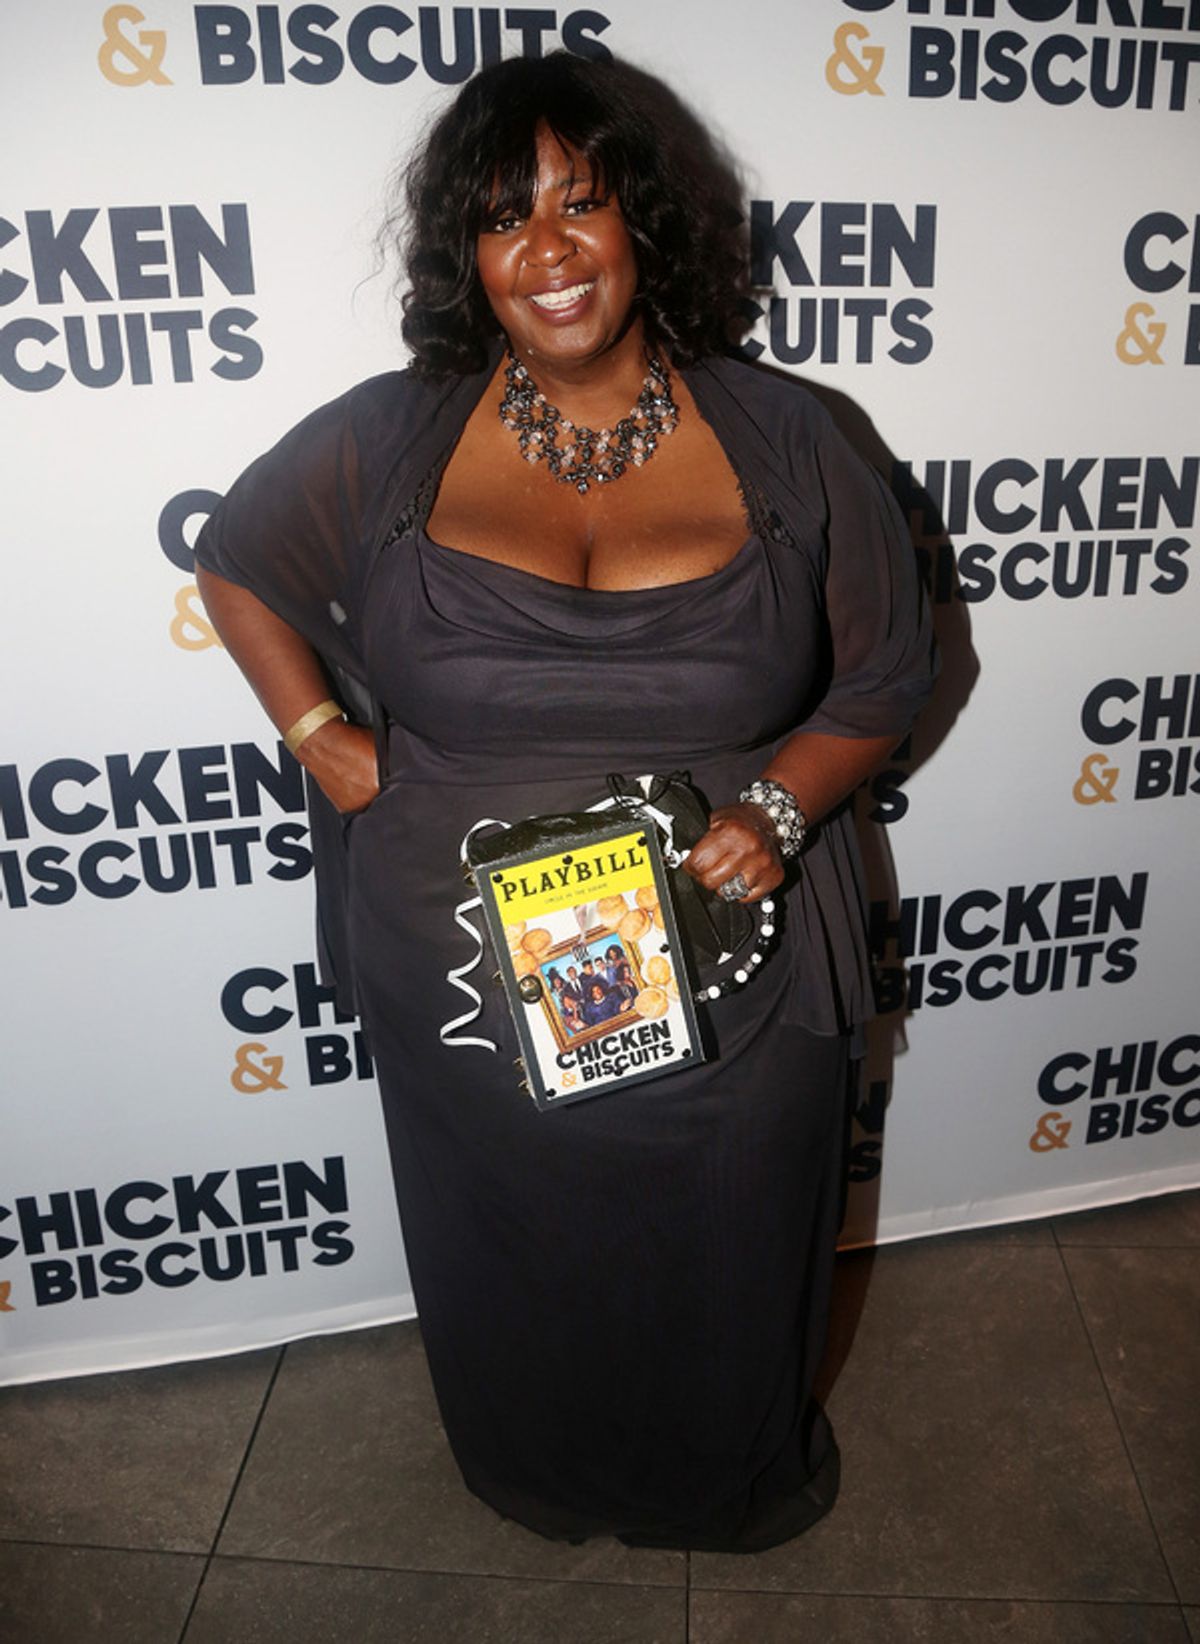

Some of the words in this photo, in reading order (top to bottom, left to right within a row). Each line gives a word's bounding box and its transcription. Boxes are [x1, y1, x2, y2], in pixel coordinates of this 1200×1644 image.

[97, 4, 174, 87] &
[193, 4, 613, 86] BISCUITS
[825, 22, 886, 96] &
[1115, 302, 1168, 366] &
[1072, 753, 1120, 806] &
[501, 846, 644, 903] PLAYBILL
[230, 1042, 289, 1095] &
[556, 1019, 671, 1070] CHICKEN
[561, 1072, 577, 1088] &
[580, 1041, 675, 1082] BISCUITS
[1029, 1111, 1073, 1153] &
[30, 1220, 355, 1307] BISCUITS
